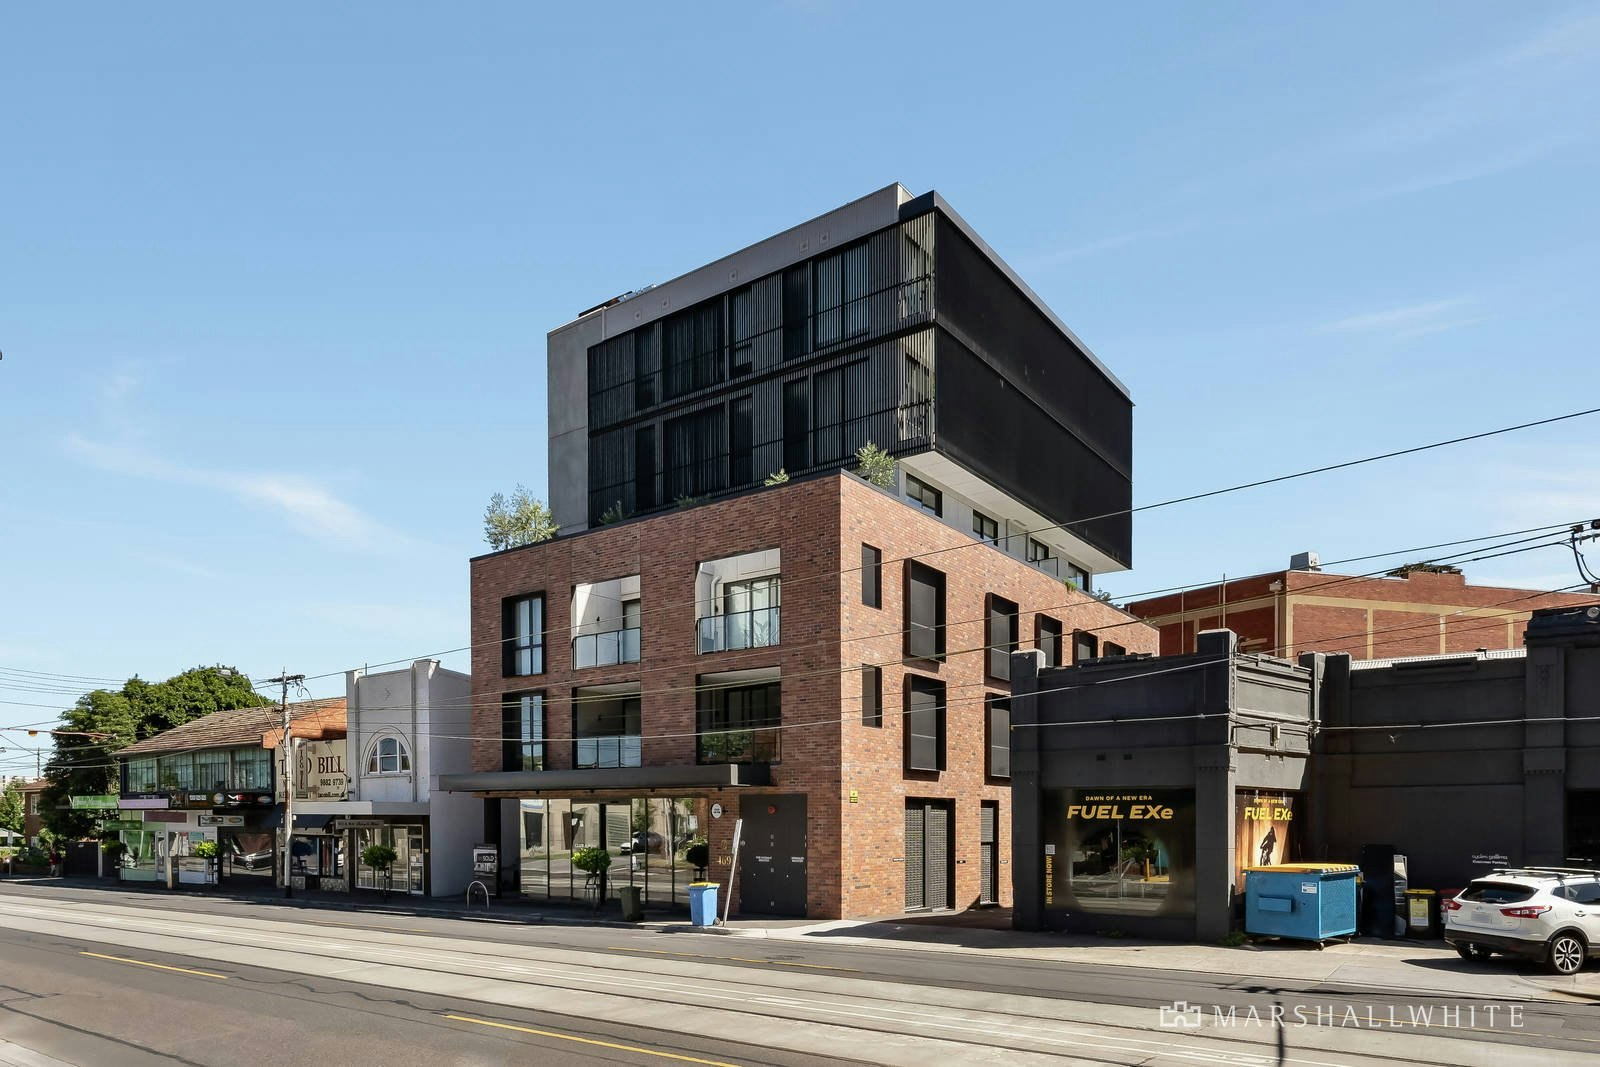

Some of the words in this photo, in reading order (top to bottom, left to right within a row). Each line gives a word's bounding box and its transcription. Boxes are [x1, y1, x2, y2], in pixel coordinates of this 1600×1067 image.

[317, 755, 345, 774] BILL
[1066, 805, 1125, 819] FUEL
[1129, 805, 1174, 819] EXe
[1244, 806, 1272, 820] FUEL
[1274, 807, 1293, 821] EXe
[1046, 896, 1053, 905] IN
